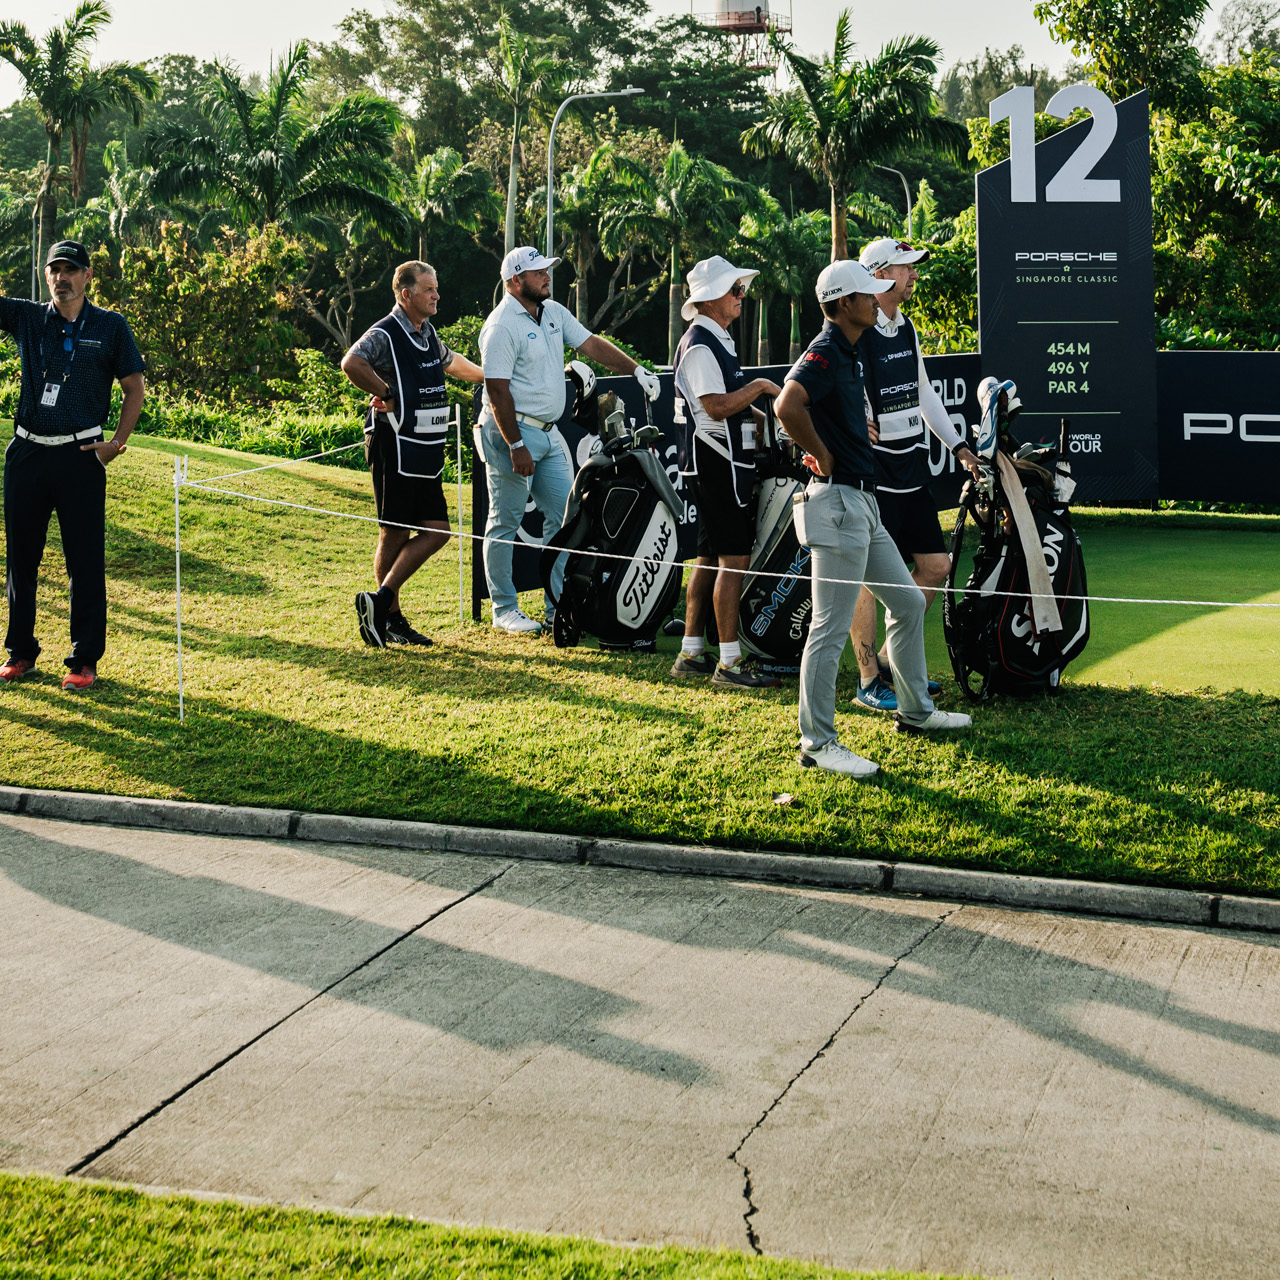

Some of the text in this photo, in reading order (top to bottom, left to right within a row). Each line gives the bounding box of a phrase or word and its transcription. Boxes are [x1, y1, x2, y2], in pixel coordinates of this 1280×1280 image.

[989, 84, 1121, 203] 12
[1015, 252, 1118, 261] PORSCHE
[1047, 343, 1090, 355] 454 M
[1047, 361, 1089, 374] 496 Y
[1048, 381, 1090, 393] PAR 4
[1069, 440, 1102, 453] OUR
[622, 521, 671, 621] Titleist
[1011, 523, 1064, 656] SON
[789, 598, 812, 640] Callaw
